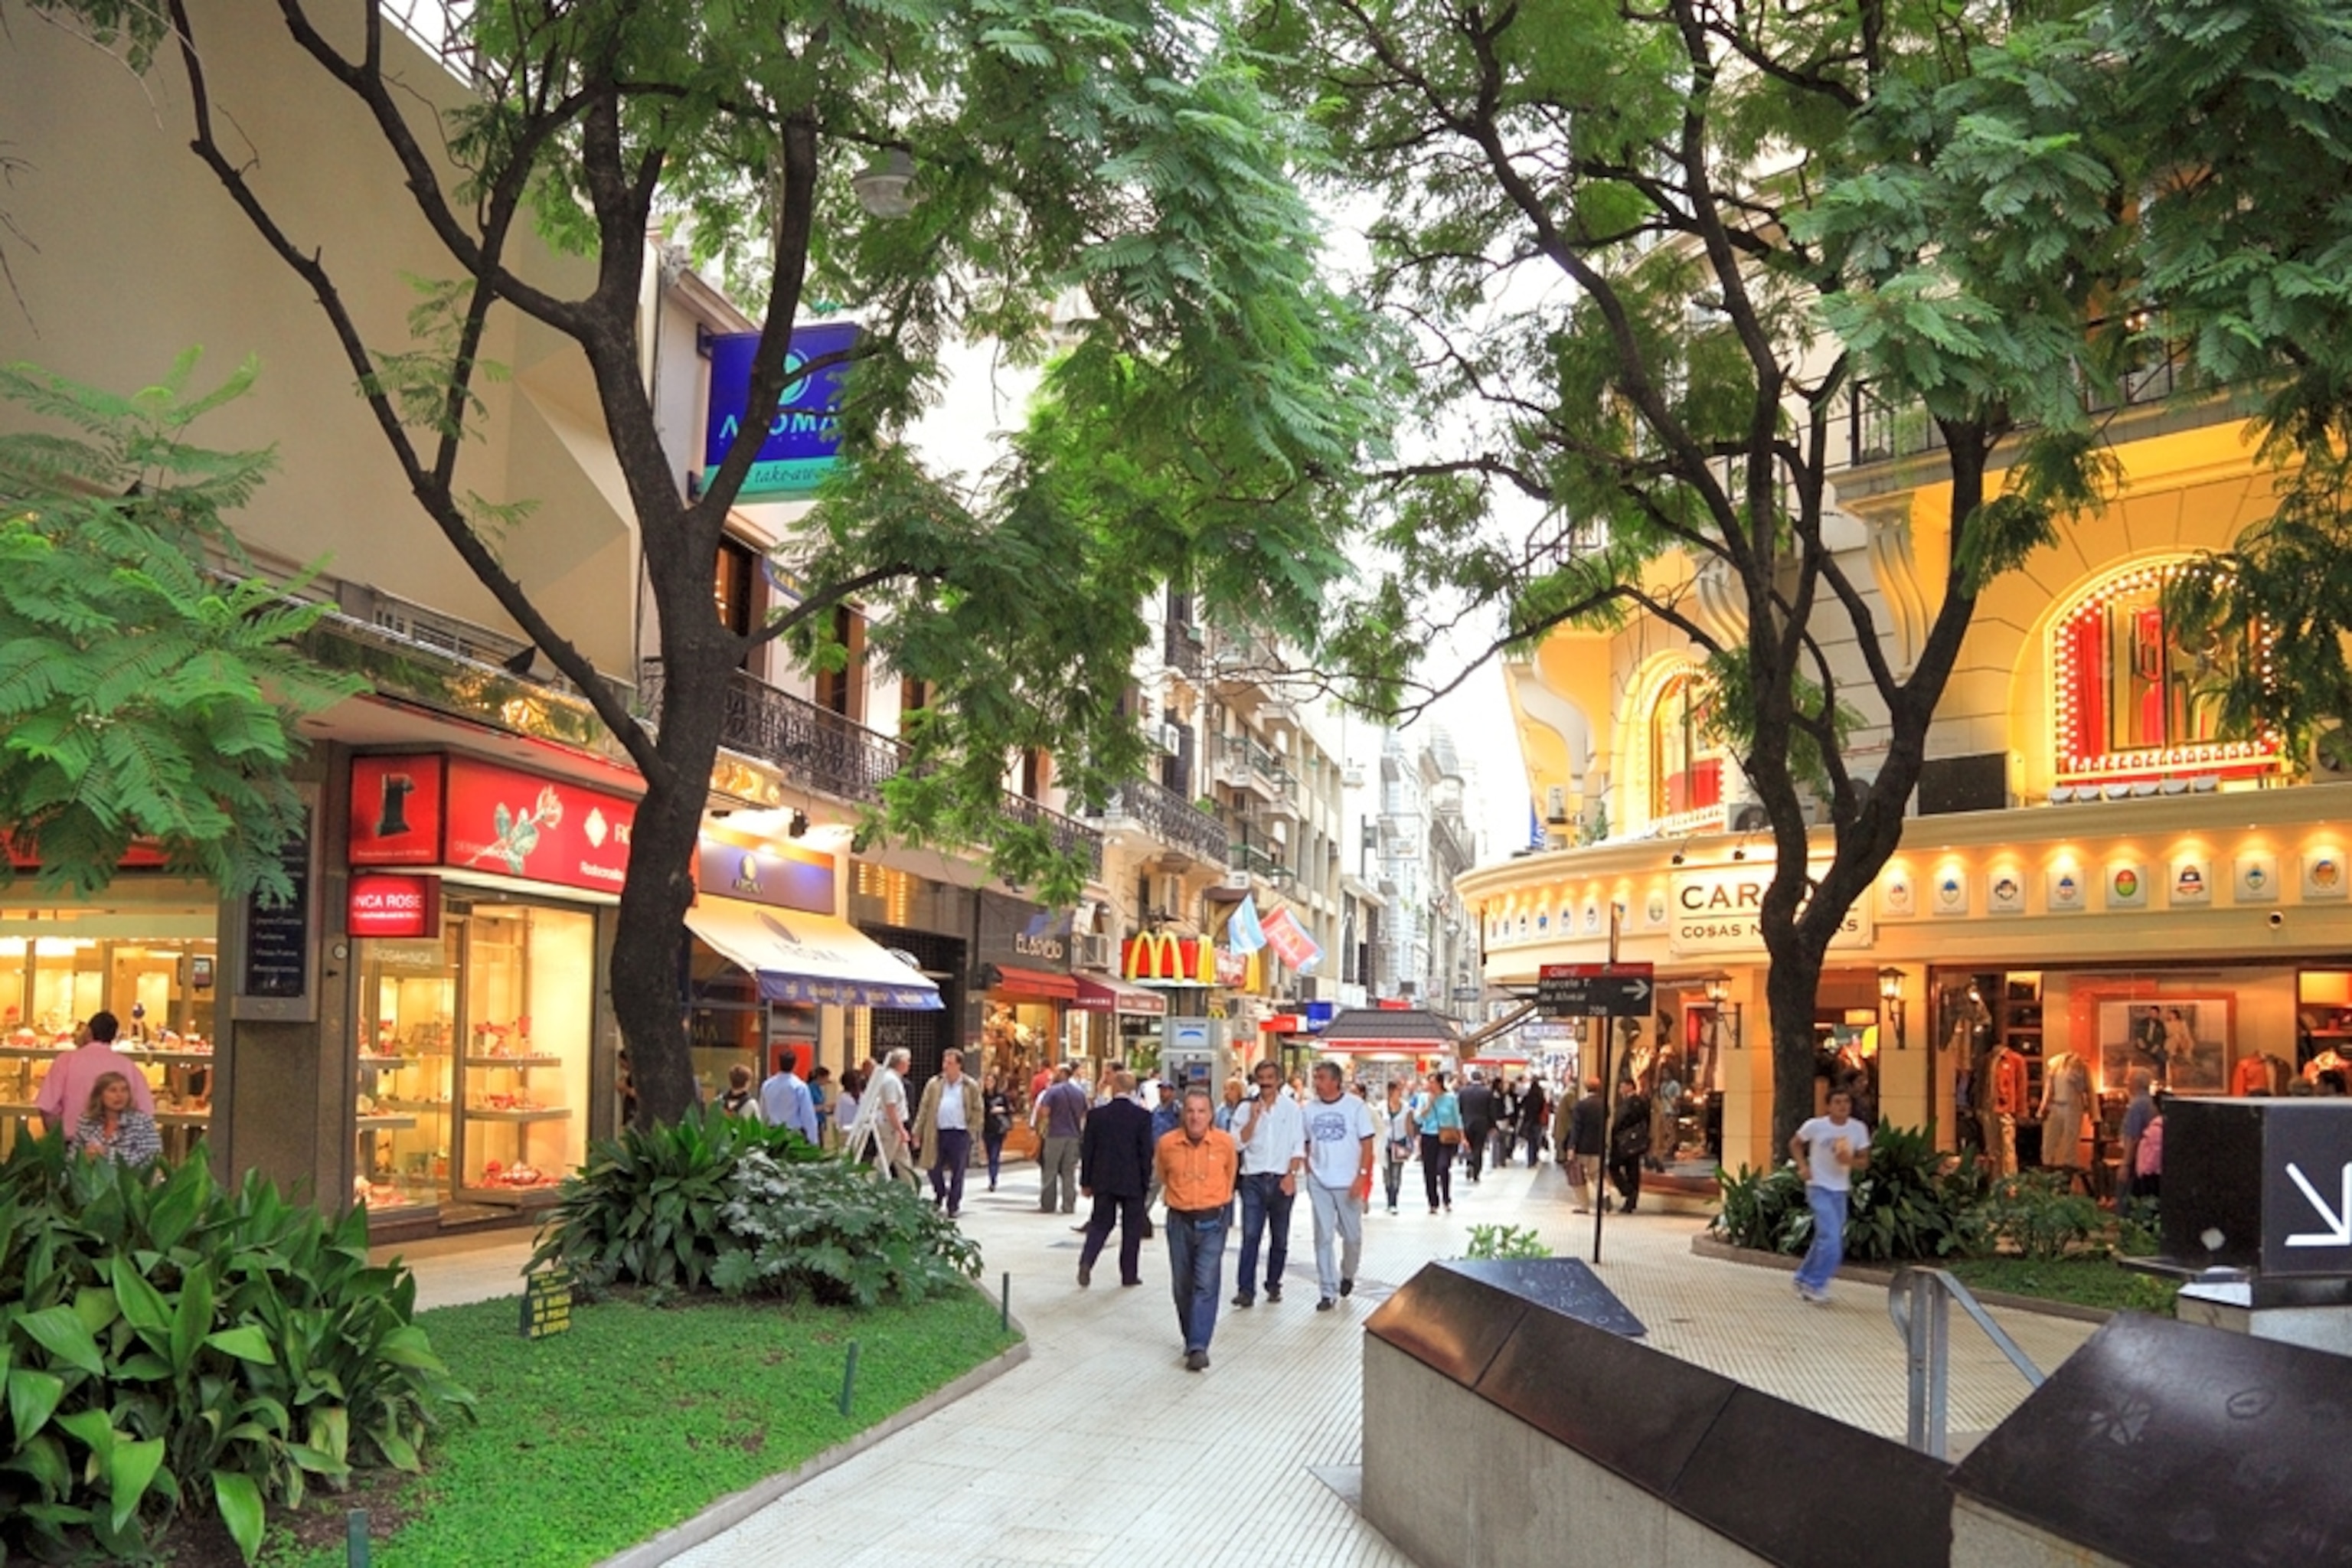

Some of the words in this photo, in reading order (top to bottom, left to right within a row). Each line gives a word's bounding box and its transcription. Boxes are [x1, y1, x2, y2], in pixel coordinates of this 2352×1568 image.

[718, 406, 839, 439] AOMA
[386, 893, 421, 909] ROSE
[1681, 923, 1742, 939] COSAS
[1540, 978, 1579, 990] Marcelo
[1583, 977, 1592, 988] T.
[1539, 992, 1552, 1002] de
[1554, 991, 1586, 1002] Alvear
